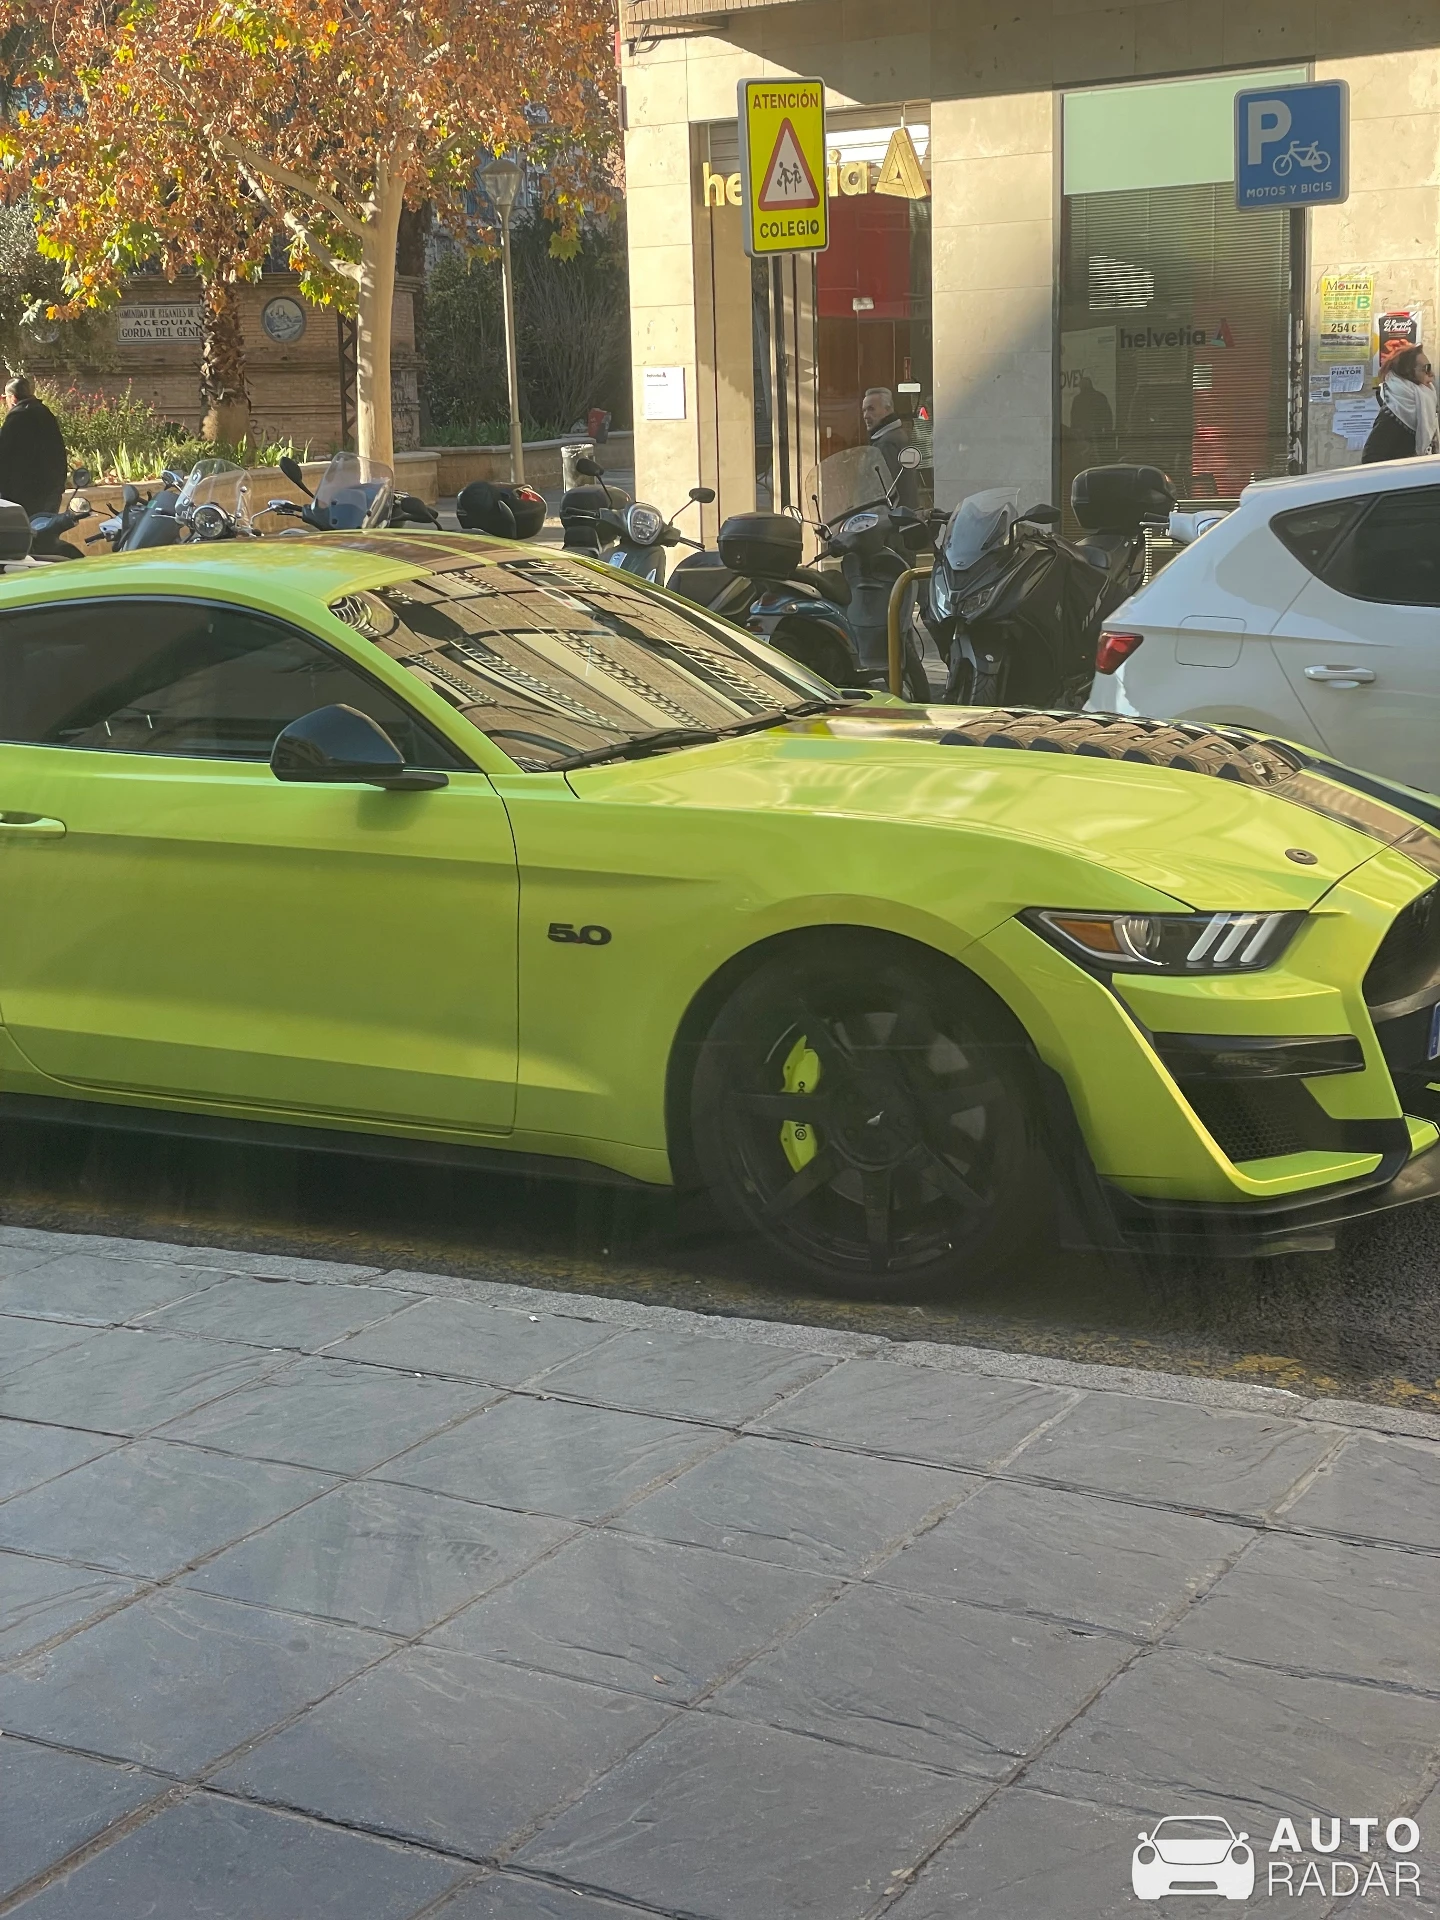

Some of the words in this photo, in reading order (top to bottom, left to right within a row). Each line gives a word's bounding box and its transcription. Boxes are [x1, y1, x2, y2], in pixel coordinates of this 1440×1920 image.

[753, 89, 819, 109] ATENCIÓN
[1247, 99, 1292, 165] P
[1246, 185, 1286, 198] MOTOS
[1290, 184, 1297, 195] Y
[1301, 181, 1333, 194] BICIS
[760, 219, 820, 239] COLEGIO
[1326, 280, 1369, 291] MOLINA
[1357, 296, 1370, 309] B
[122, 328, 152, 337] GORDA
[156, 327, 173, 337] DEL
[1120, 325, 1206, 349] helvetia
[1331, 323, 1350, 333] 254
[548, 923, 612, 946] 5.0
